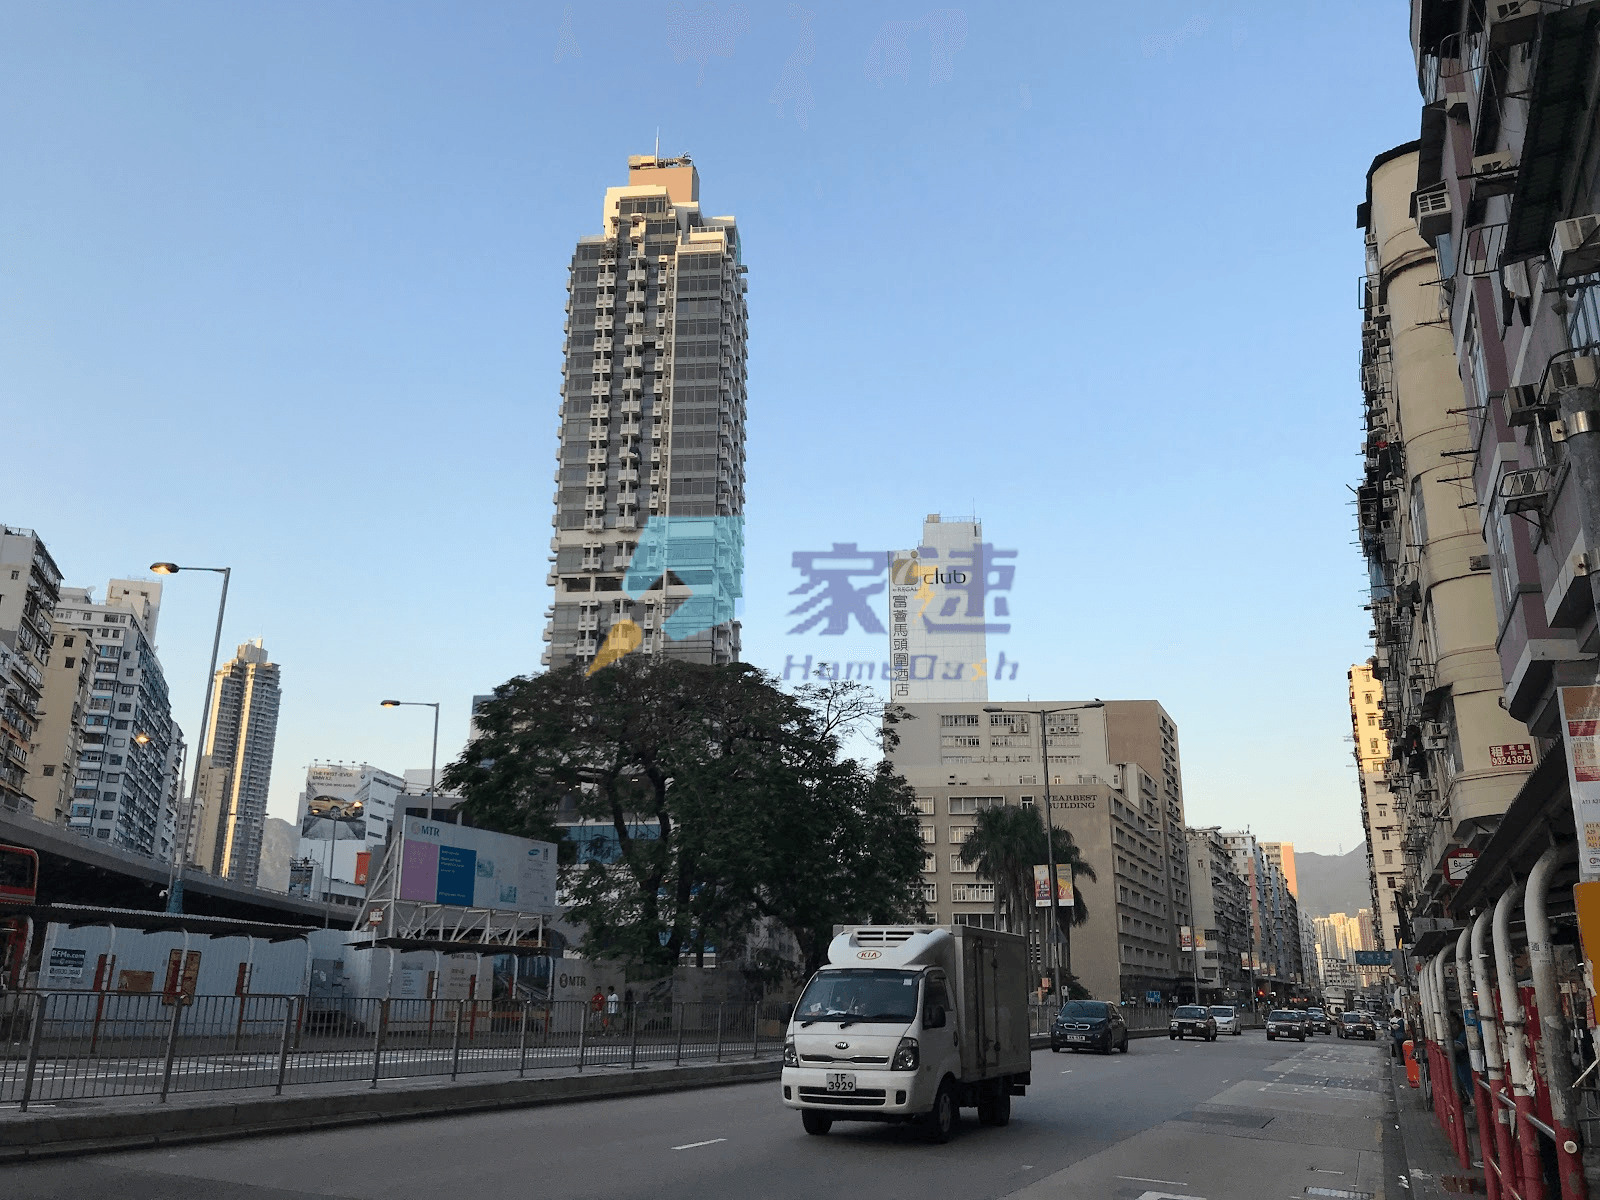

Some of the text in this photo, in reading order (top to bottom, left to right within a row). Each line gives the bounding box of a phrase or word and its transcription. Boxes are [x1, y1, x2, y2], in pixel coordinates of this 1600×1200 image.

[892, 594, 909, 697] 富薈馬頭圍酒店
[1490, 746, 1504, 757] 租
[1491, 755, 1532, 765] 93243879
[421, 825, 440, 837] MTR
[568, 975, 587, 987] MTR
[833, 1073, 847, 1082] TF
[828, 1081, 854, 1091] 3929
